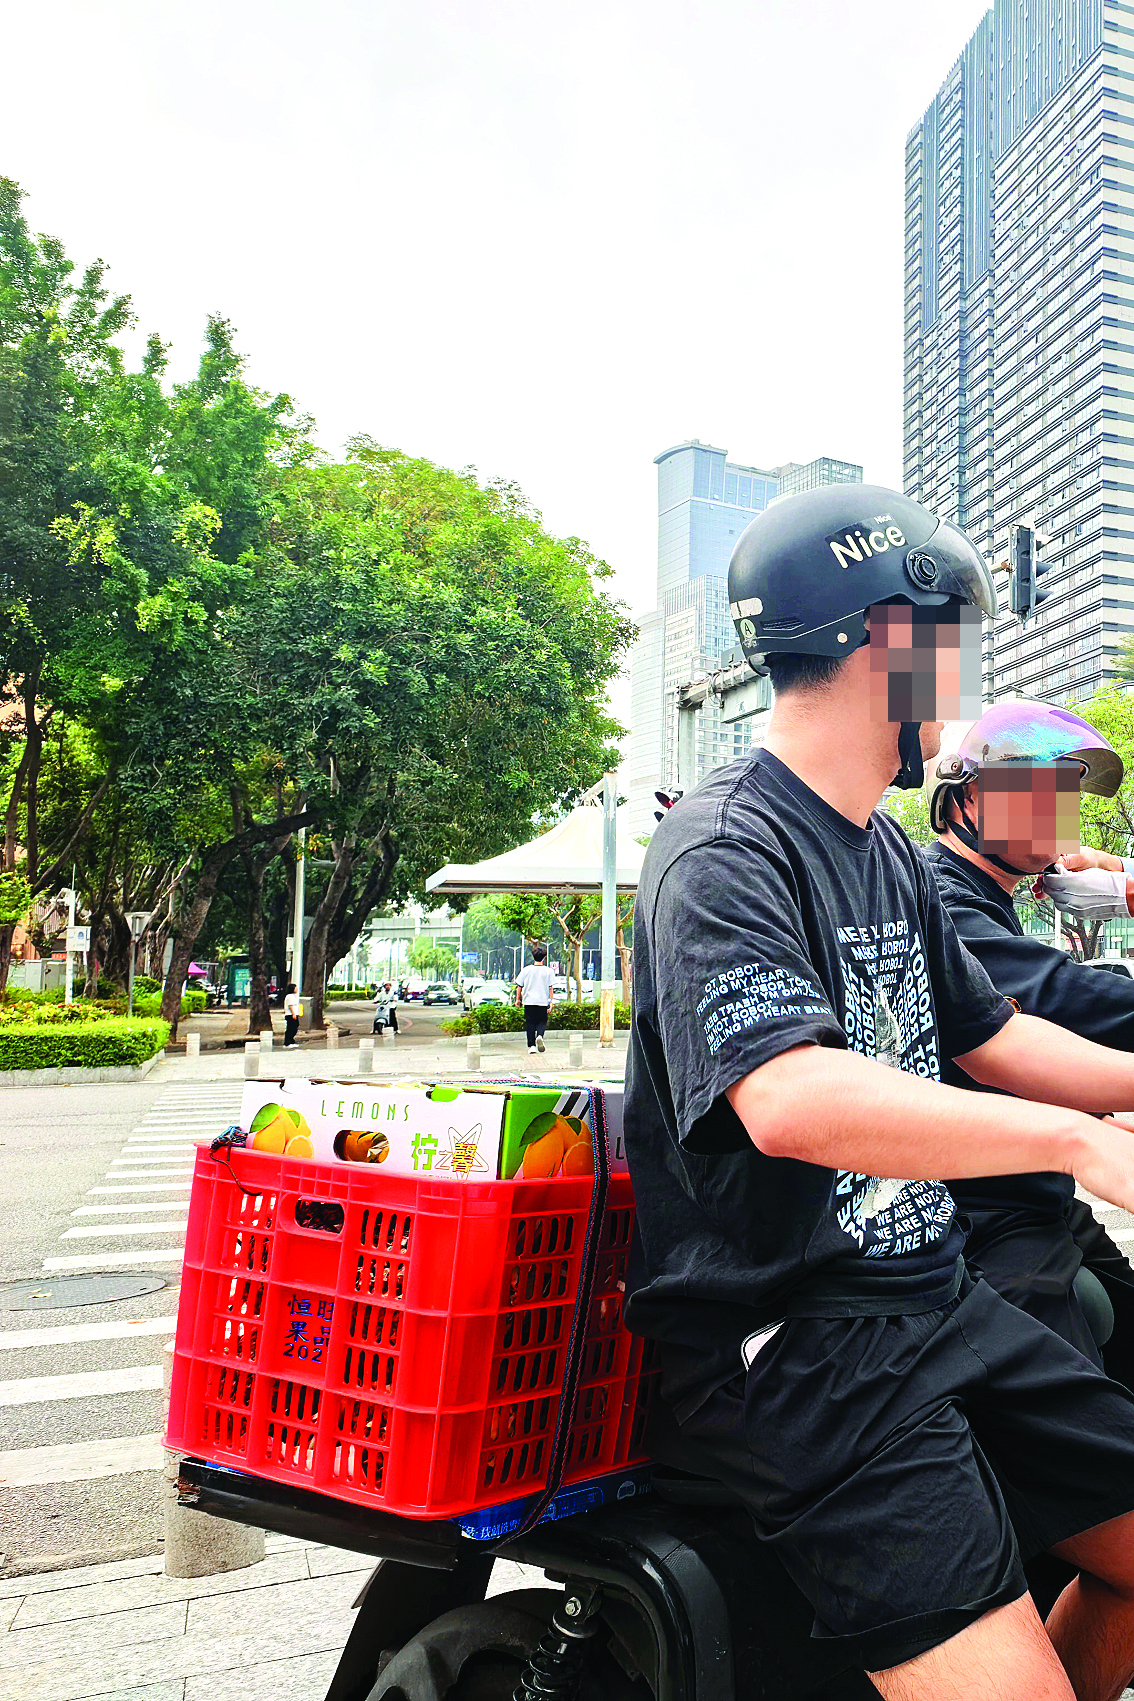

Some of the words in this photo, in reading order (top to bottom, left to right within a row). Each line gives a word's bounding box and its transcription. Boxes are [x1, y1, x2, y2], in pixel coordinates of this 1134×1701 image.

[873, 514, 892, 525] Nice
[829, 525, 906, 569] Nice
[717, 963, 760, 985] ROBOT
[730, 977, 748, 991] MY
[732, 1000, 773, 1022] ROBOT
[743, 1014, 761, 1028] MY
[763, 1005, 802, 1019] HEART
[860, 978, 877, 1061] ROBOT
[321, 1099, 410, 1122] LEMONS
[875, 1211, 893, 1227] WE
[893, 1201, 914, 1221] ARE
[873, 1226, 894, 1240] WE
[894, 1215, 923, 1236] ARE
[862, 1241, 891, 1258] WE
[889, 1230, 922, 1257] ARE
